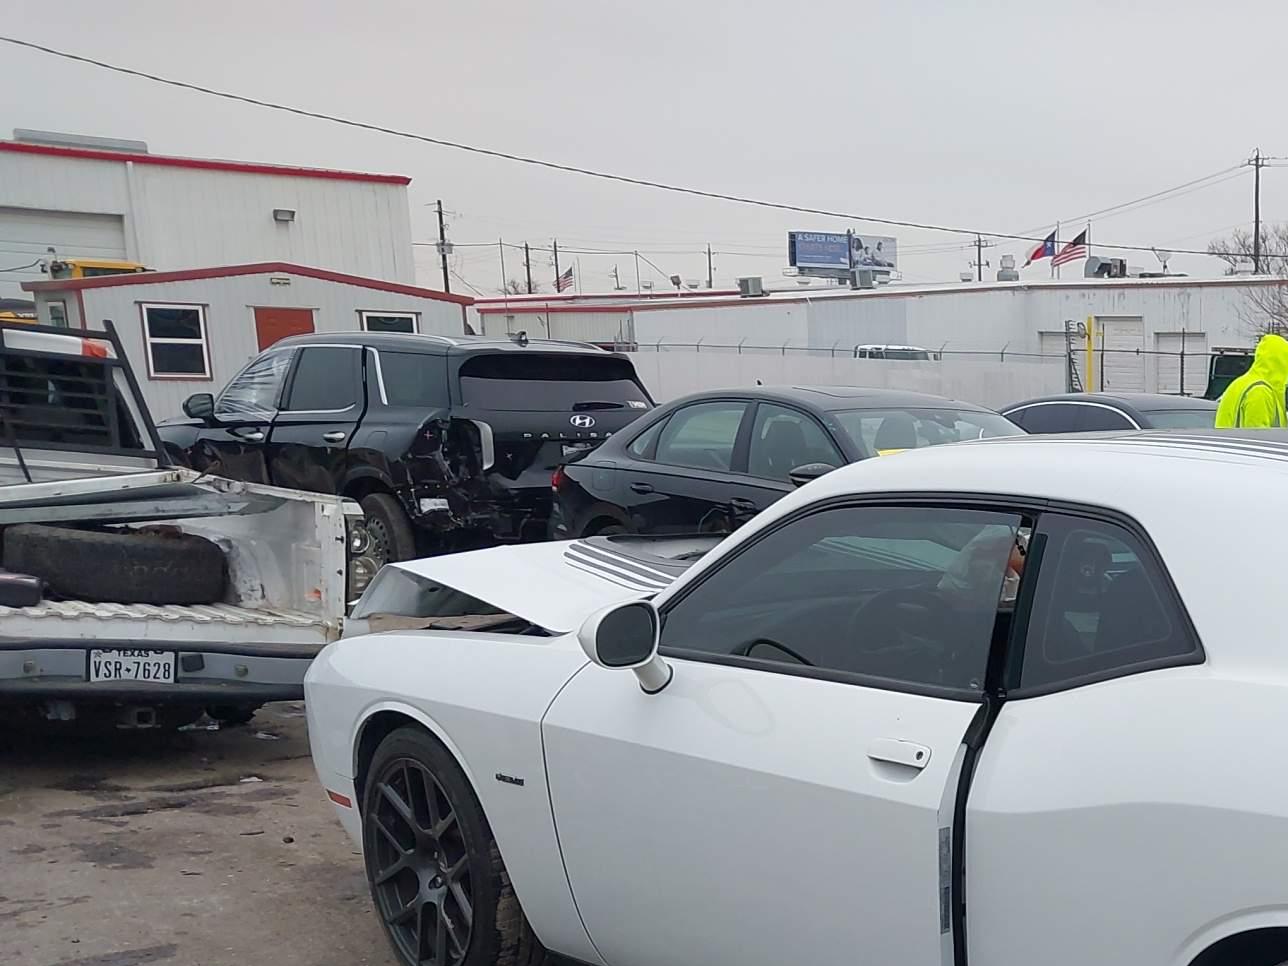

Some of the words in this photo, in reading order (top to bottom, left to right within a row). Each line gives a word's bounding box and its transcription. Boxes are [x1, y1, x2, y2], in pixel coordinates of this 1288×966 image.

[804, 233, 826, 242] SAFER
[827, 235, 848, 243] HOME
[117, 649, 150, 657] TEXAS
